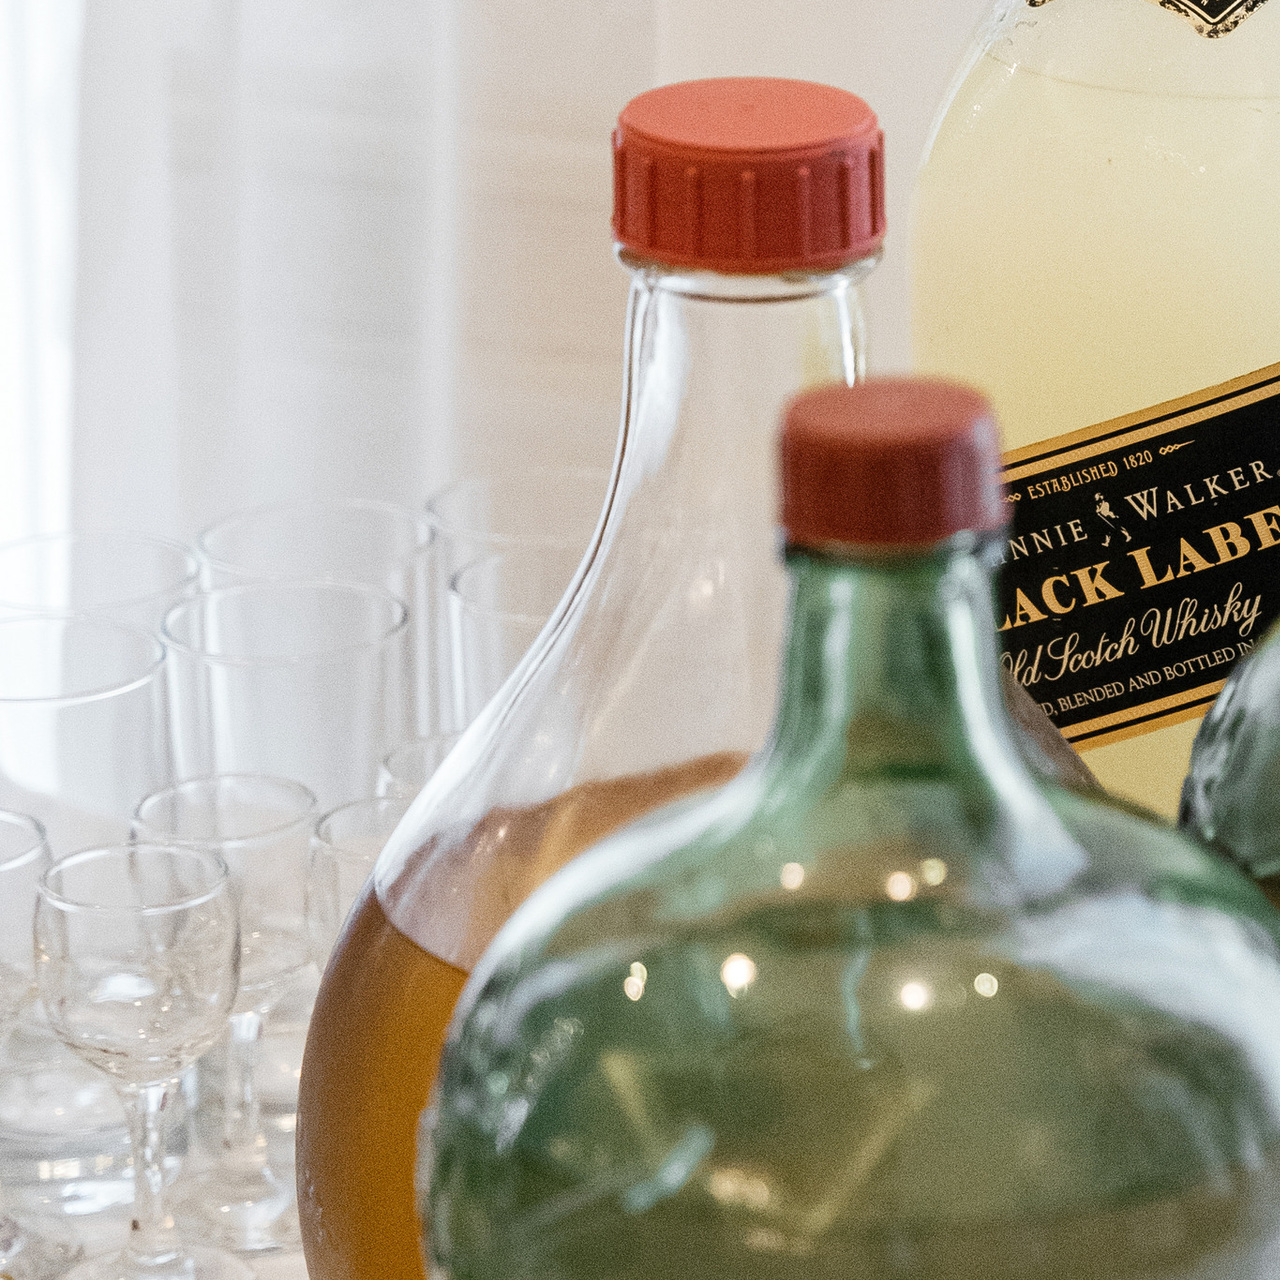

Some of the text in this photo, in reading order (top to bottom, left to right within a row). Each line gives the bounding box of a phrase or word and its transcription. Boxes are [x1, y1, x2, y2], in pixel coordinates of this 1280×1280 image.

[1026, 449, 1154, 500] ESTABLISHED 1820
[1004, 519, 1089, 563] NNIE
[1043, 616, 1140, 682] Scotch
[1140, 581, 1263, 650] Whisky
[1060, 677, 1126, 714] BLENDED
[1129, 669, 1162, 693] AND
[1165, 646, 1236, 681] BOTTLED
